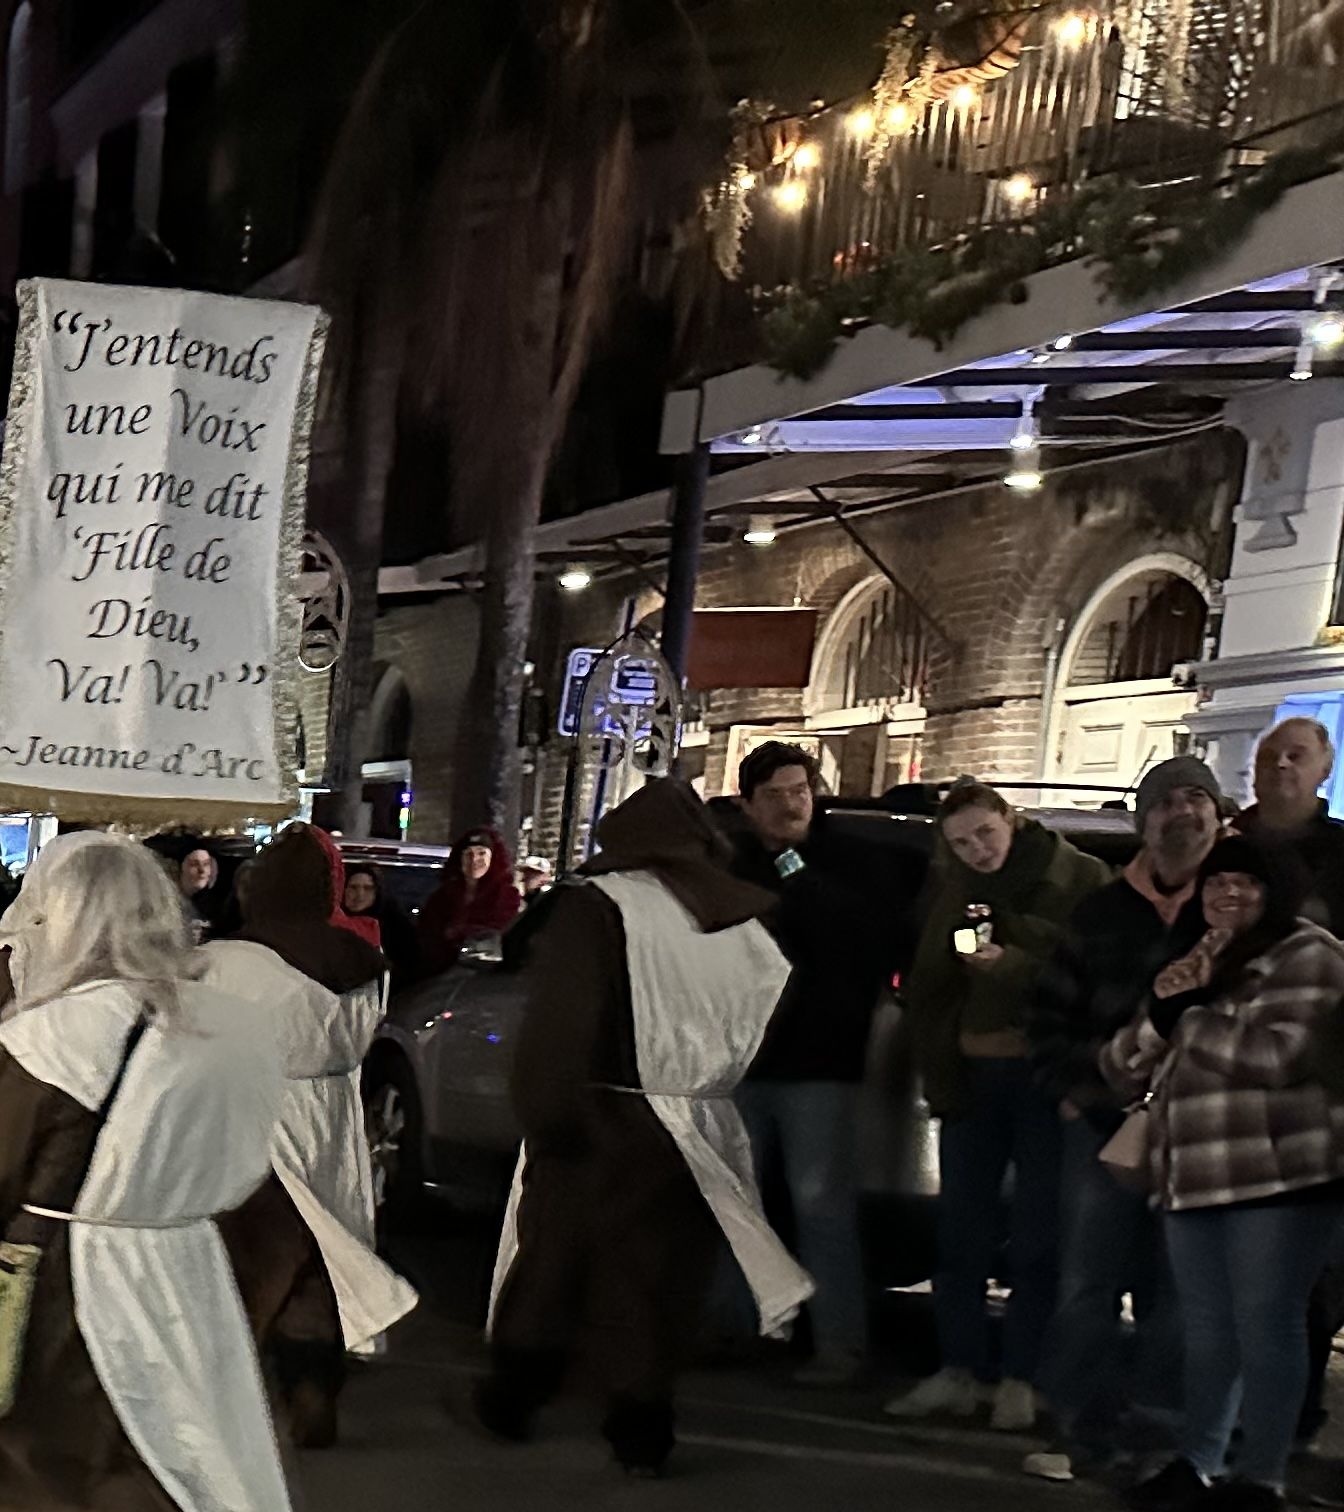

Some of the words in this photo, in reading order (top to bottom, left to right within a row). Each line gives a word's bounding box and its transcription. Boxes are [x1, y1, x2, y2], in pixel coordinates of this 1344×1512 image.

[65, 401, 152, 436] une
[171, 389, 266, 453] Voix
[47, 463, 122, 519] qui
[134, 470, 193, 508] me
[204, 473, 269, 522] dit
[183, 537, 232, 583] de
[87, 598, 201, 653] Dieu,
[46, 658, 132, 706] Va!
